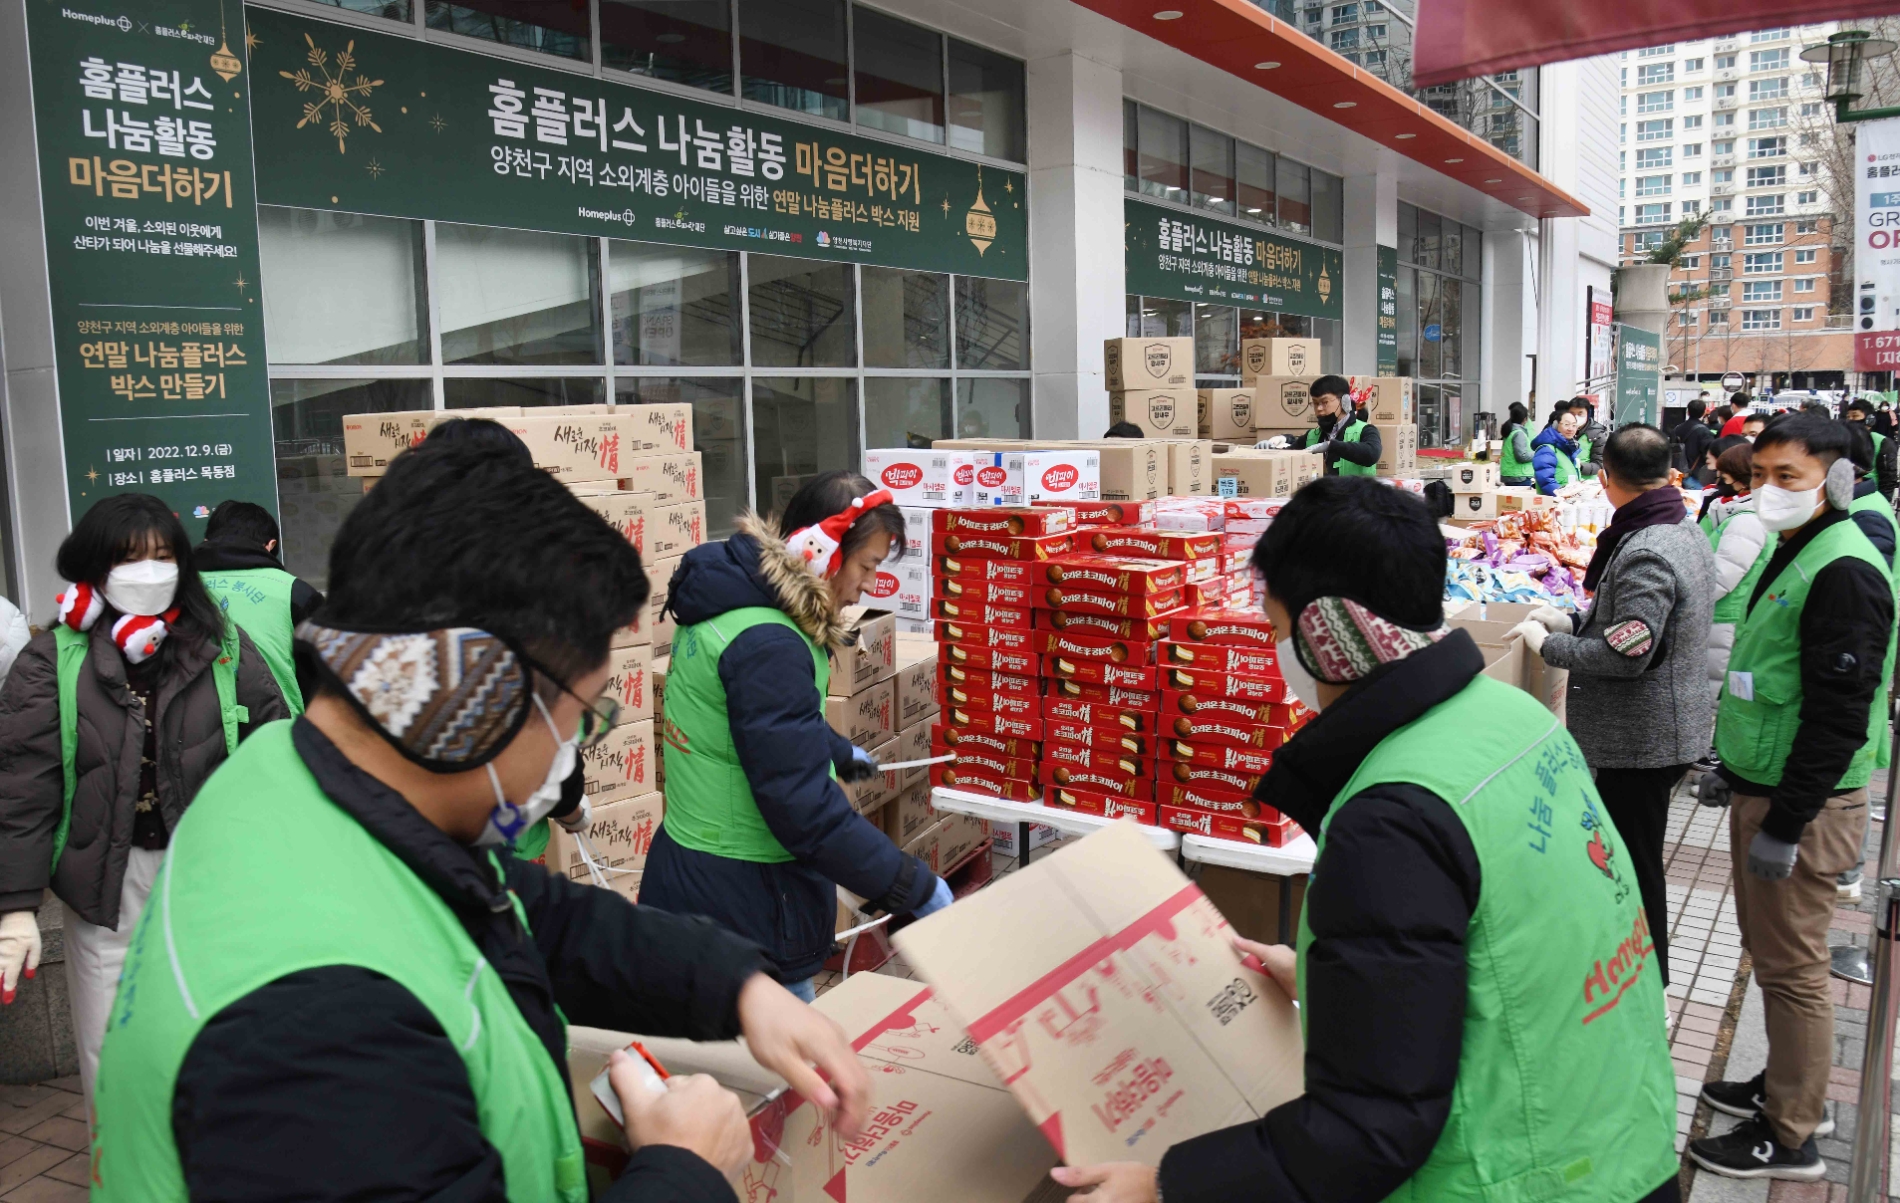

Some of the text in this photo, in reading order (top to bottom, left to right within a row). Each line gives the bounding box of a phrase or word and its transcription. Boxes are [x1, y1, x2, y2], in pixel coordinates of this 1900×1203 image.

[62, 8, 116, 27] Homeplus
[79, 56, 214, 110] 홈플러스
[82, 108, 217, 160] 나눔활동
[488, 78, 921, 205] 홈플러스 나눔활동 마음더하기
[69, 156, 233, 208] 마음더하기
[490, 145, 921, 233] 양천구 지역 소외계층 아이들을 위한 연말 나눔플러스 박스 지원
[578, 206, 622, 222] Homeplus
[85, 216, 222, 240] 이번 겨울, 소외된 이웃에게
[73, 235, 237, 258] 산타가 되어 나눔을 선물해주세요!
[1158, 217, 1301, 275] 홈플러스 나눔활동 마음더하기
[1158, 254, 1301, 292] 양천구 지역 소외계층 아이들을 위한 연말 나눔플러스 박스 지원
[77, 320, 244, 336] 양천구 지역 소외계층 아이들을 위한
[79, 341, 247, 368] 연말 나눔플러스
[110, 373, 226, 401] 박스 만들기
[648, 411, 666, 425] 새로운
[659, 419, 673, 438] 시작
[380, 421, 401, 438] 새로운
[554, 425, 584, 443] 새로운
[674, 418, 686, 450] 情
[574, 437, 598, 460] 시작
[599, 433, 619, 474] 情
[150, 467, 199, 483] 홈플러스
[201, 464, 235, 479] 목동점
[662, 462, 678, 476] 새로운
[685, 467, 697, 498] 情
[923, 482, 946, 491] 마시멜로
[690, 511, 701, 545] 情
[958, 515, 991, 531] 초코파이
[959, 539, 1009, 555] 오리온 초코파이
[1105, 537, 1157, 554] 오리온 초코파이
[1062, 570, 1117, 587] 오리온 초코파이
[231, 580, 267, 605] 봉사단
[1061, 593, 1116, 611] 오리온 초코파이
[1205, 625, 1268, 643] 오리온 초코파이
[624, 669, 644, 708] 情
[880, 698, 890, 731] 情
[1052, 706, 1080, 717] 초코파이
[1195, 700, 1257, 719] 오리온 초코파이
[957, 734, 1006, 752] 오리온 초코파이
[1190, 725, 1250, 743] 오리온 초코파이
[581, 743, 608, 762] 새로운
[600, 751, 624, 773] 시작
[624, 744, 646, 784] 情
[1069, 774, 1123, 793] 오리온 초코파이
[589, 820, 618, 840] 새로운
[609, 825, 633, 848] 시작
[633, 818, 653, 855] 情
[1527, 796, 1553, 855] 나눔
